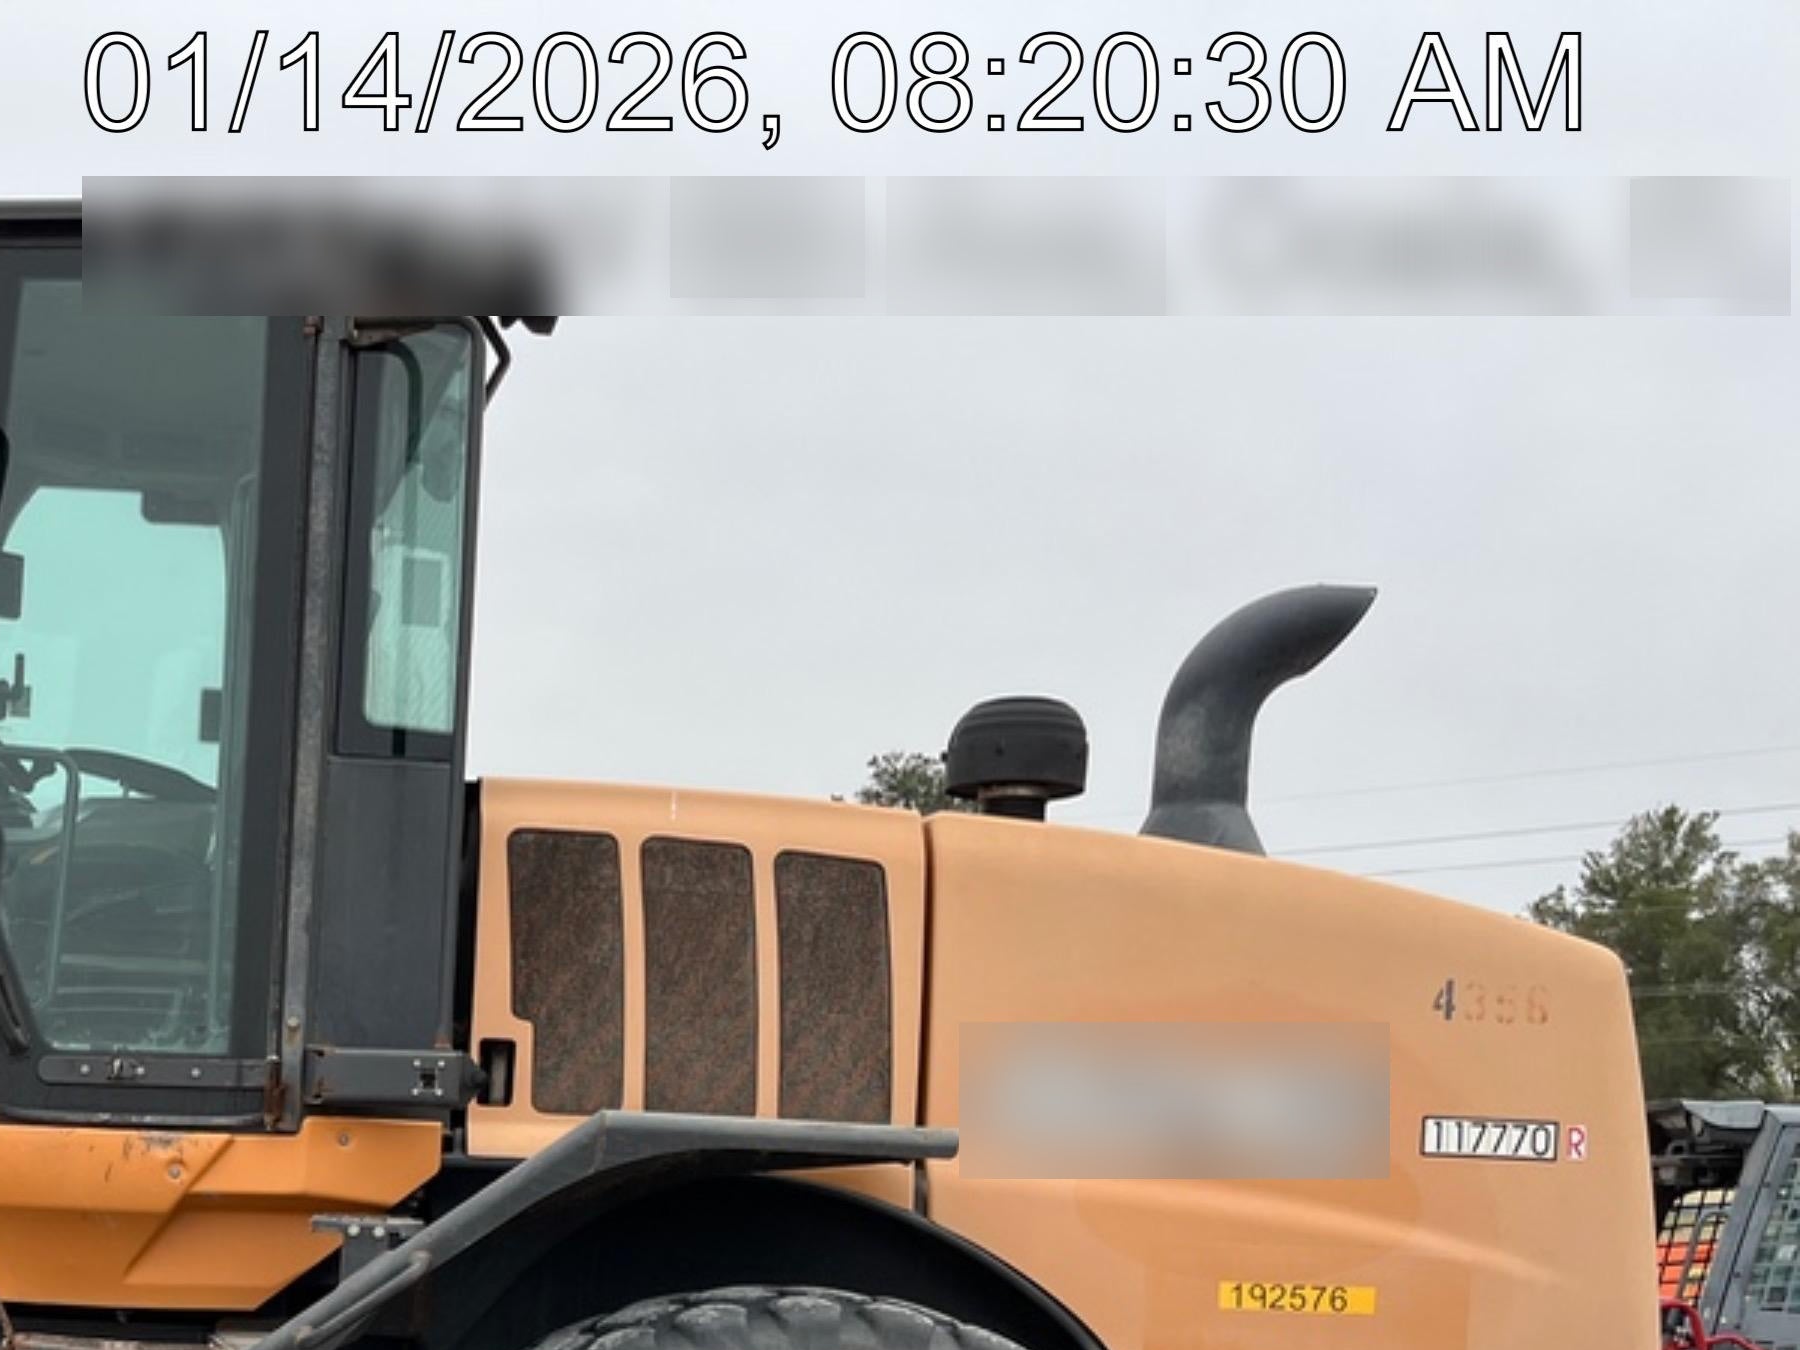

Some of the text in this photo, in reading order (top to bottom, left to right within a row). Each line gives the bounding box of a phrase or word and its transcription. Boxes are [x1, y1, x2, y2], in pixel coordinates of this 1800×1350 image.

[1433, 1120, 1585, 1157] 117770 R
[1232, 1283, 1349, 1312] 192576
